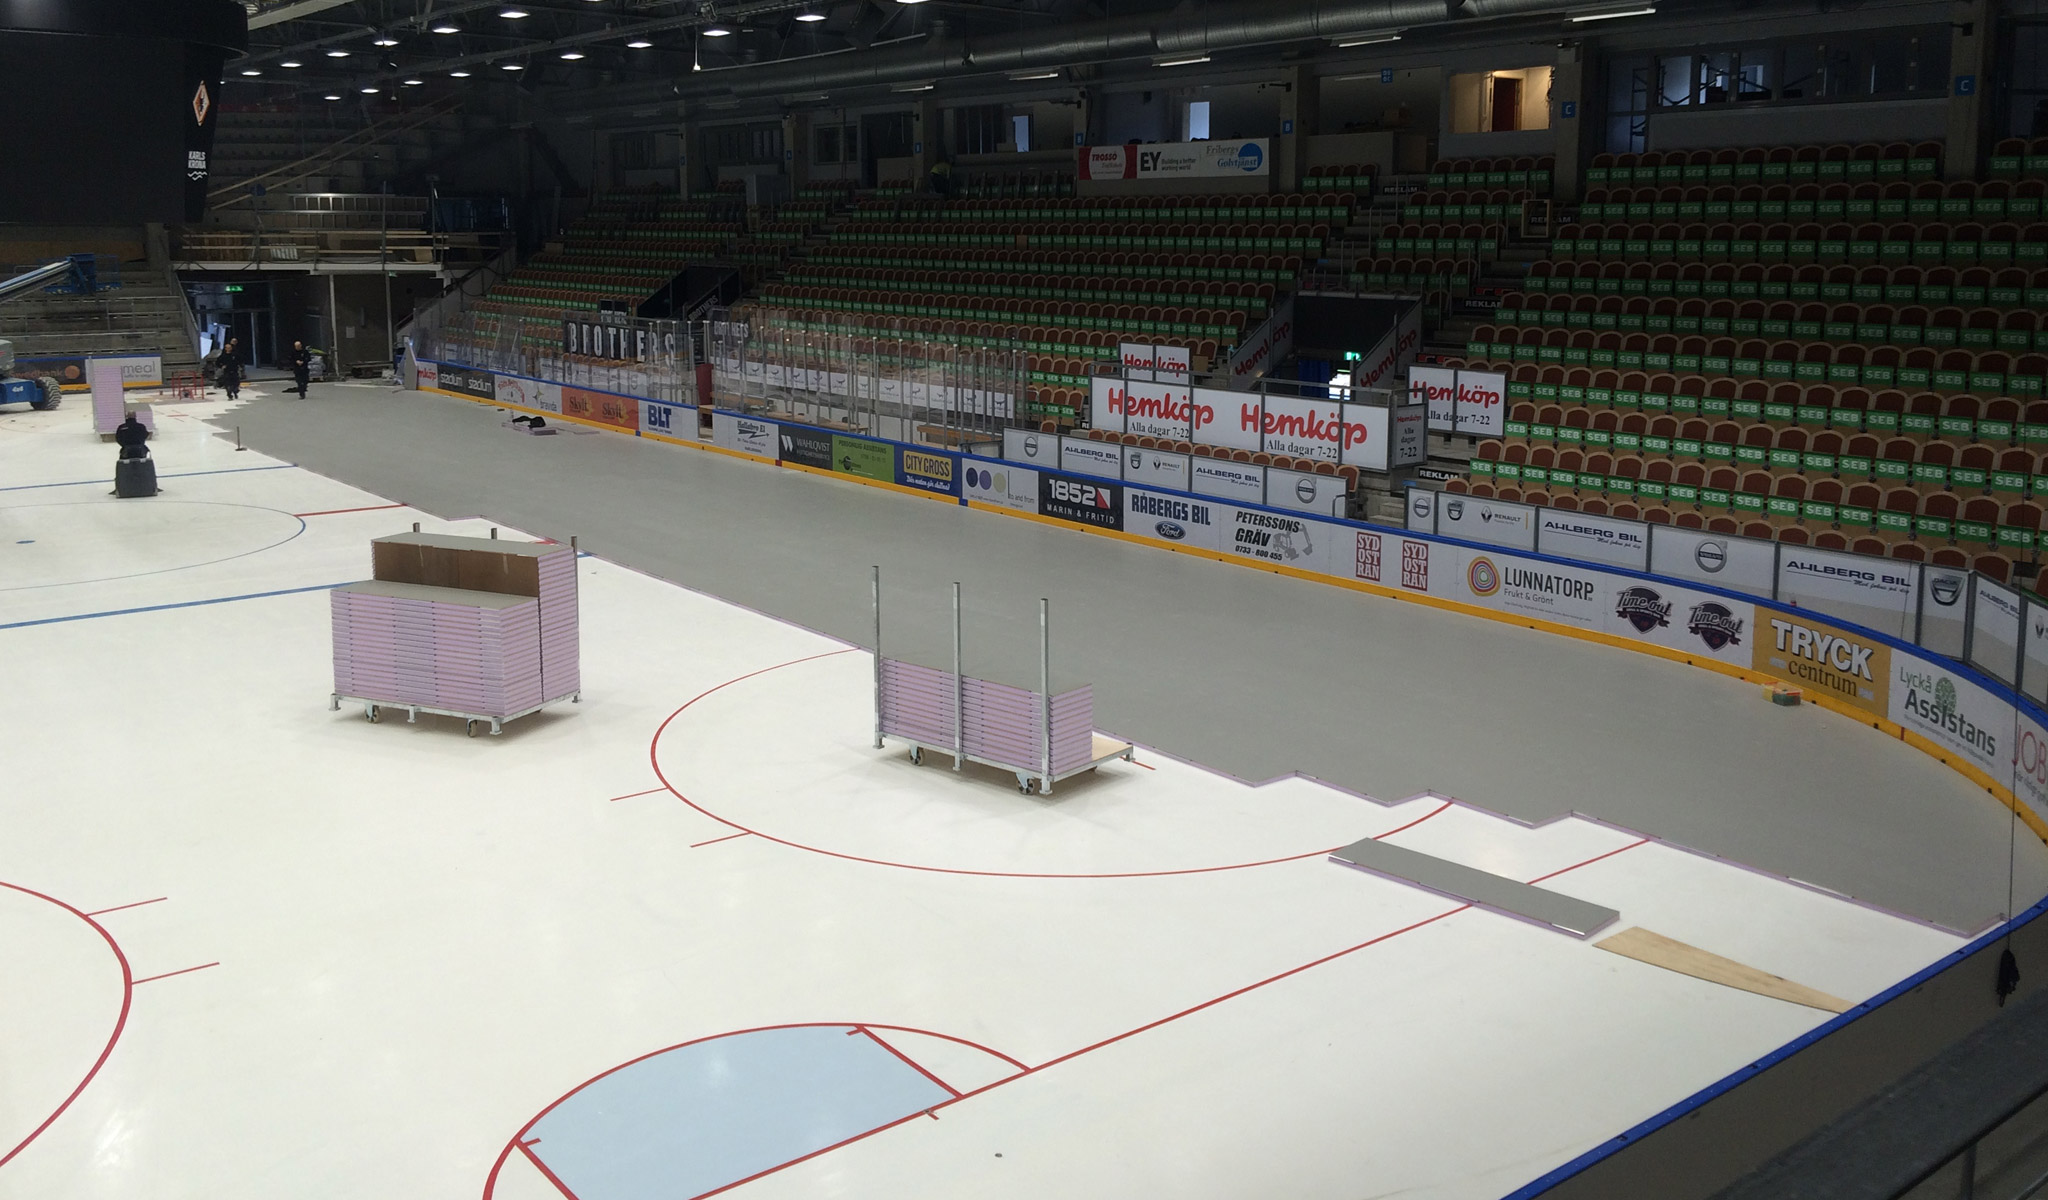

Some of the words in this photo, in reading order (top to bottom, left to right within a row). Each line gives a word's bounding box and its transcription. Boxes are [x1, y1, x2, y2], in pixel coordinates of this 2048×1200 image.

[188, 151, 206, 160] KARLS
[1140, 151, 1161, 172] EY
[1217, 155, 1258, 169] Golvtjänst
[187, 160, 207, 169] KRONA
[1705, 359, 1729, 369] SEB
[441, 372, 462, 387] stadium
[1832, 368, 1855, 377] SEB
[12, 385, 24, 393] 4x4
[468, 378, 492, 392] stadium
[1974, 377, 2000, 387] SEB
[1562, 388, 1581, 398] SEB
[1644, 396, 1665, 405] SEB
[1108, 387, 1214, 430] Hemköp
[1767, 406, 1793, 418] SEB
[648, 404, 672, 429] BLT
[1471, 414, 1490, 425] 7-22
[1869, 415, 1894, 425] SEB
[1130, 421, 1146, 434] Alla
[1147, 423, 1171, 438] dagar
[1172, 426, 1189, 438] 7-22
[1241, 403, 1368, 450] Hemköp
[1404, 427, 1414, 435] Alla
[1980, 423, 2008, 435] SEB
[796, 437, 830, 452] WAHLQVIST
[1401, 436, 1416, 444] dagar
[1616, 435, 1637, 445] SEB
[1064, 446, 1104, 458] AHLBERG
[1105, 452, 1118, 460] BIL
[1266, 439, 1286, 451] Alla
[1287, 441, 1316, 456] dagar
[1317, 446, 1337, 458] 7-22
[1400, 446, 1417, 458] 7-22
[1707, 445, 1729, 455] SEB
[905, 454, 923, 471] CITY
[923, 457, 950, 477] GROSS
[1472, 462, 1491, 471] SEB
[1807, 456, 1832, 467] SEB
[1196, 466, 1242, 480] AHLBERG
[1245, 473, 1260, 482] BIL
[1525, 469, 1544, 478] SEB
[1581, 476, 1601, 486] SEB
[1954, 471, 1982, 482] SEB
[1049, 478, 1096, 507] 1852
[1640, 484, 1662, 494] SEB
[1704, 492, 1727, 502] SEB
[1131, 492, 1189, 521] RÅBERGS
[1192, 506, 1211, 526] BIL
[1770, 500, 1795, 511] SEB
[1047, 503, 1073, 515] MARIN
[1085, 511, 1115, 524] FRITID
[1494, 513, 1521, 523] RENAULT
[1842, 509, 1869, 521] SEB
[1235, 511, 1300, 533] PETERSSONS
[1919, 520, 1946, 532] SEB
[1160, 523, 1181, 538] Ford
[1235, 528, 1271, 547] GRÄV
[1545, 521, 1614, 538] AHLBERG
[1619, 531, 1642, 543] BIL
[2000, 530, 2030, 543] SEB
[1358, 533, 1380, 551] SYD
[1235, 545, 1251, 555] 0733
[1255, 549, 1268, 558] 800
[1269, 552, 1283, 561] 455
[1358, 549, 1380, 565] OST
[1403, 542, 1427, 560] SYD
[1357, 562, 1380, 579] RAN
[1404, 557, 1427, 574] OST
[1403, 571, 1427, 589] RAN
[1787, 561, 1875, 581] AHLBERG
[1881, 575, 1911, 587] BIL
[1504, 567, 1594, 600] LUNNATORP
[1504, 588, 1524, 599] Frukt
[1532, 594, 1554, 606] Grönt
[1616, 590, 1646, 609] Time
[1648, 601, 1673, 617] out
[1979, 589, 2009, 609] AHLBERG
[1687, 605, 1718, 625] Time
[1720, 617, 1744, 634] out
[1770, 618, 1874, 682] TRYCK
[1788, 660, 1858, 697] centrum
[1900, 666, 1932, 694] Lyckå
[1904, 688, 1996, 757] Assistans
